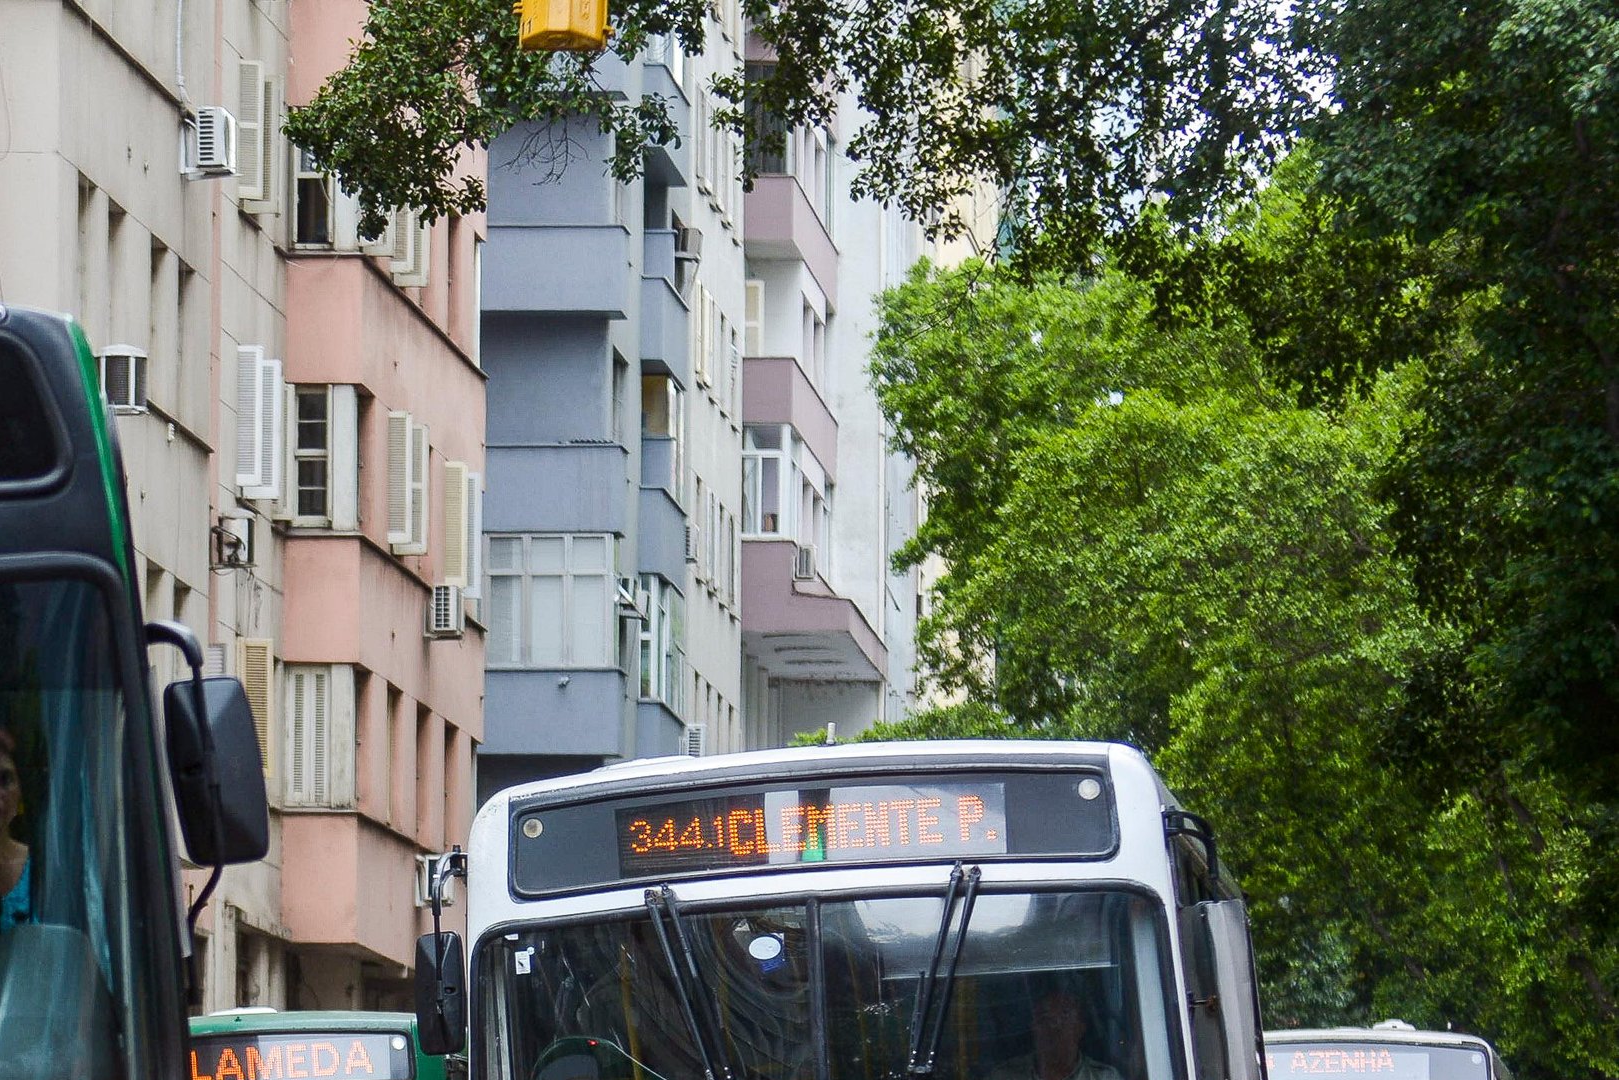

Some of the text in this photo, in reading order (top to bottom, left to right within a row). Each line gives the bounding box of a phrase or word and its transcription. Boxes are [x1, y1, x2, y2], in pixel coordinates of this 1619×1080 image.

[630, 815, 724, 853] 344.1
[728, 797, 941, 856] CLEMENTE
[1290, 1048, 1394, 1073] AZENHA
